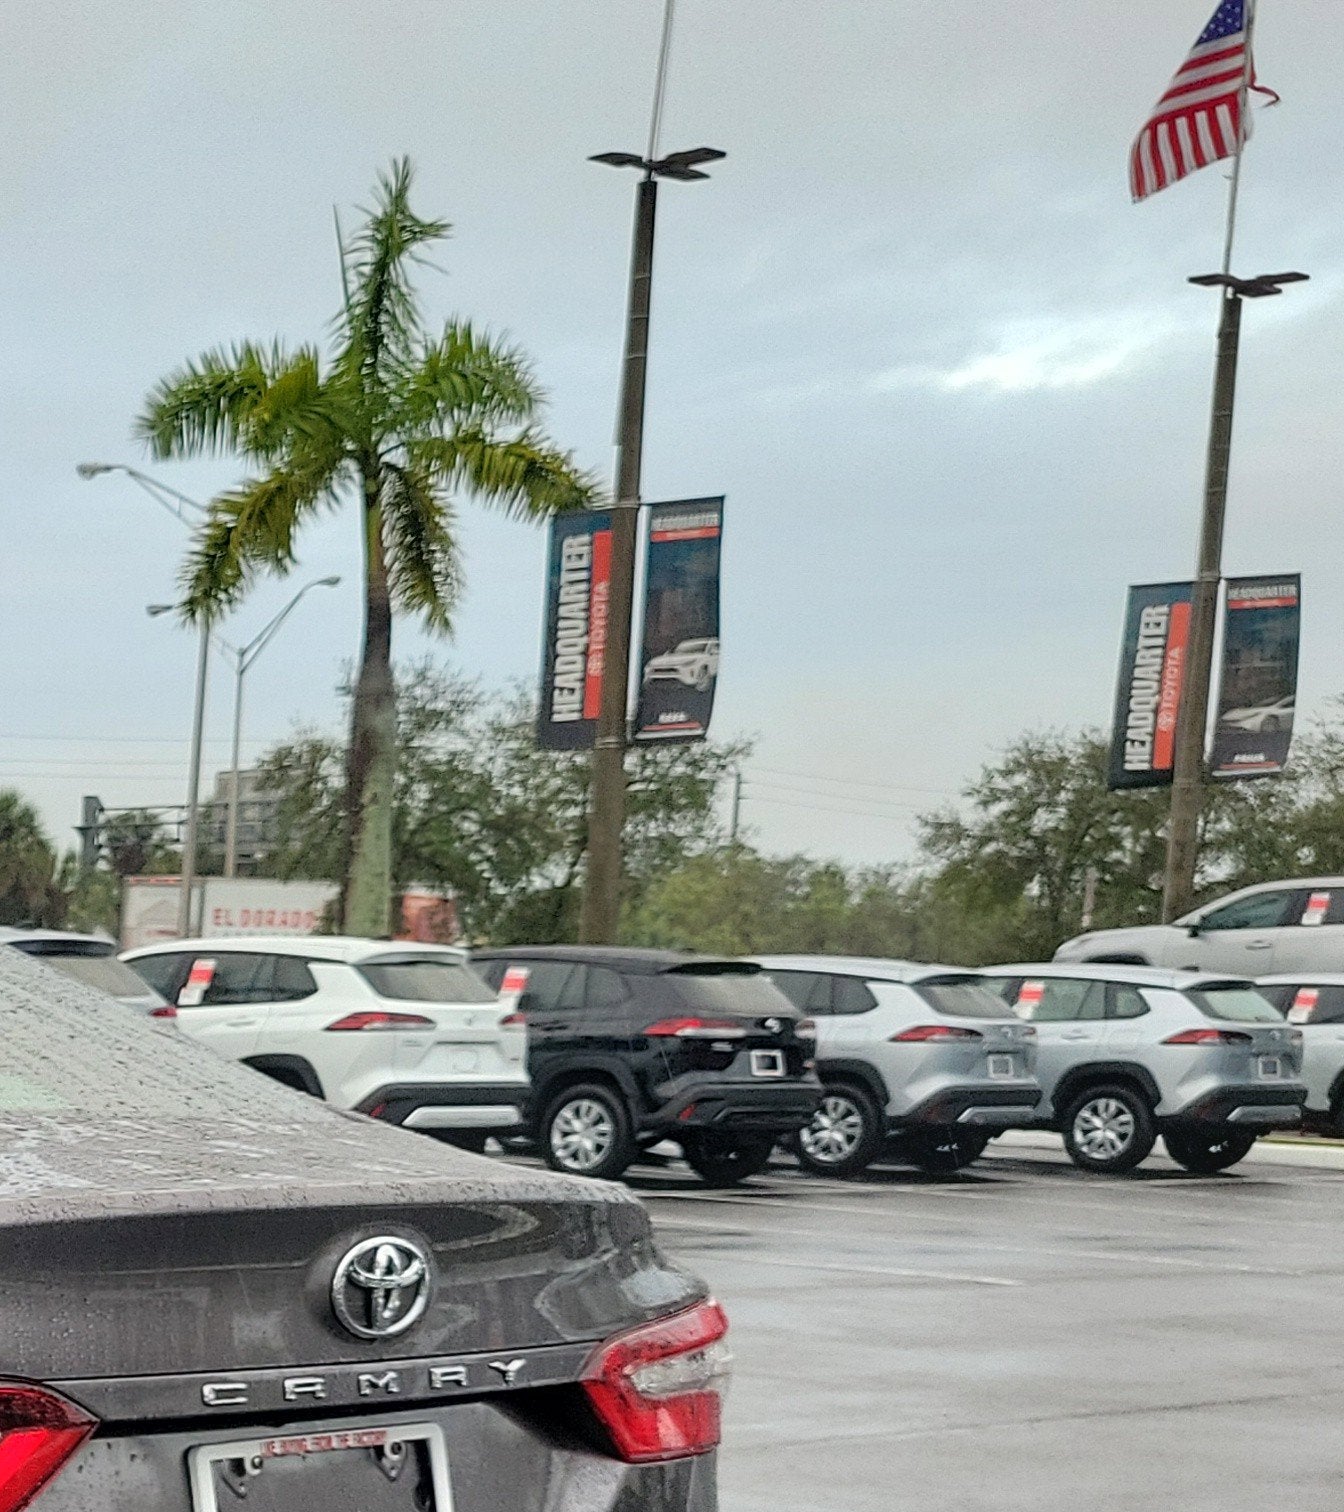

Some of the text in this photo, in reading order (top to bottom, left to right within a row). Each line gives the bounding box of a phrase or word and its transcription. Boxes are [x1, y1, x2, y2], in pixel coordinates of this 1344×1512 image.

[551, 533, 593, 723] HEADQUARTER
[1123, 604, 1169, 771] HEADQUARTER
[201, 1358, 526, 1406] CAMRY
